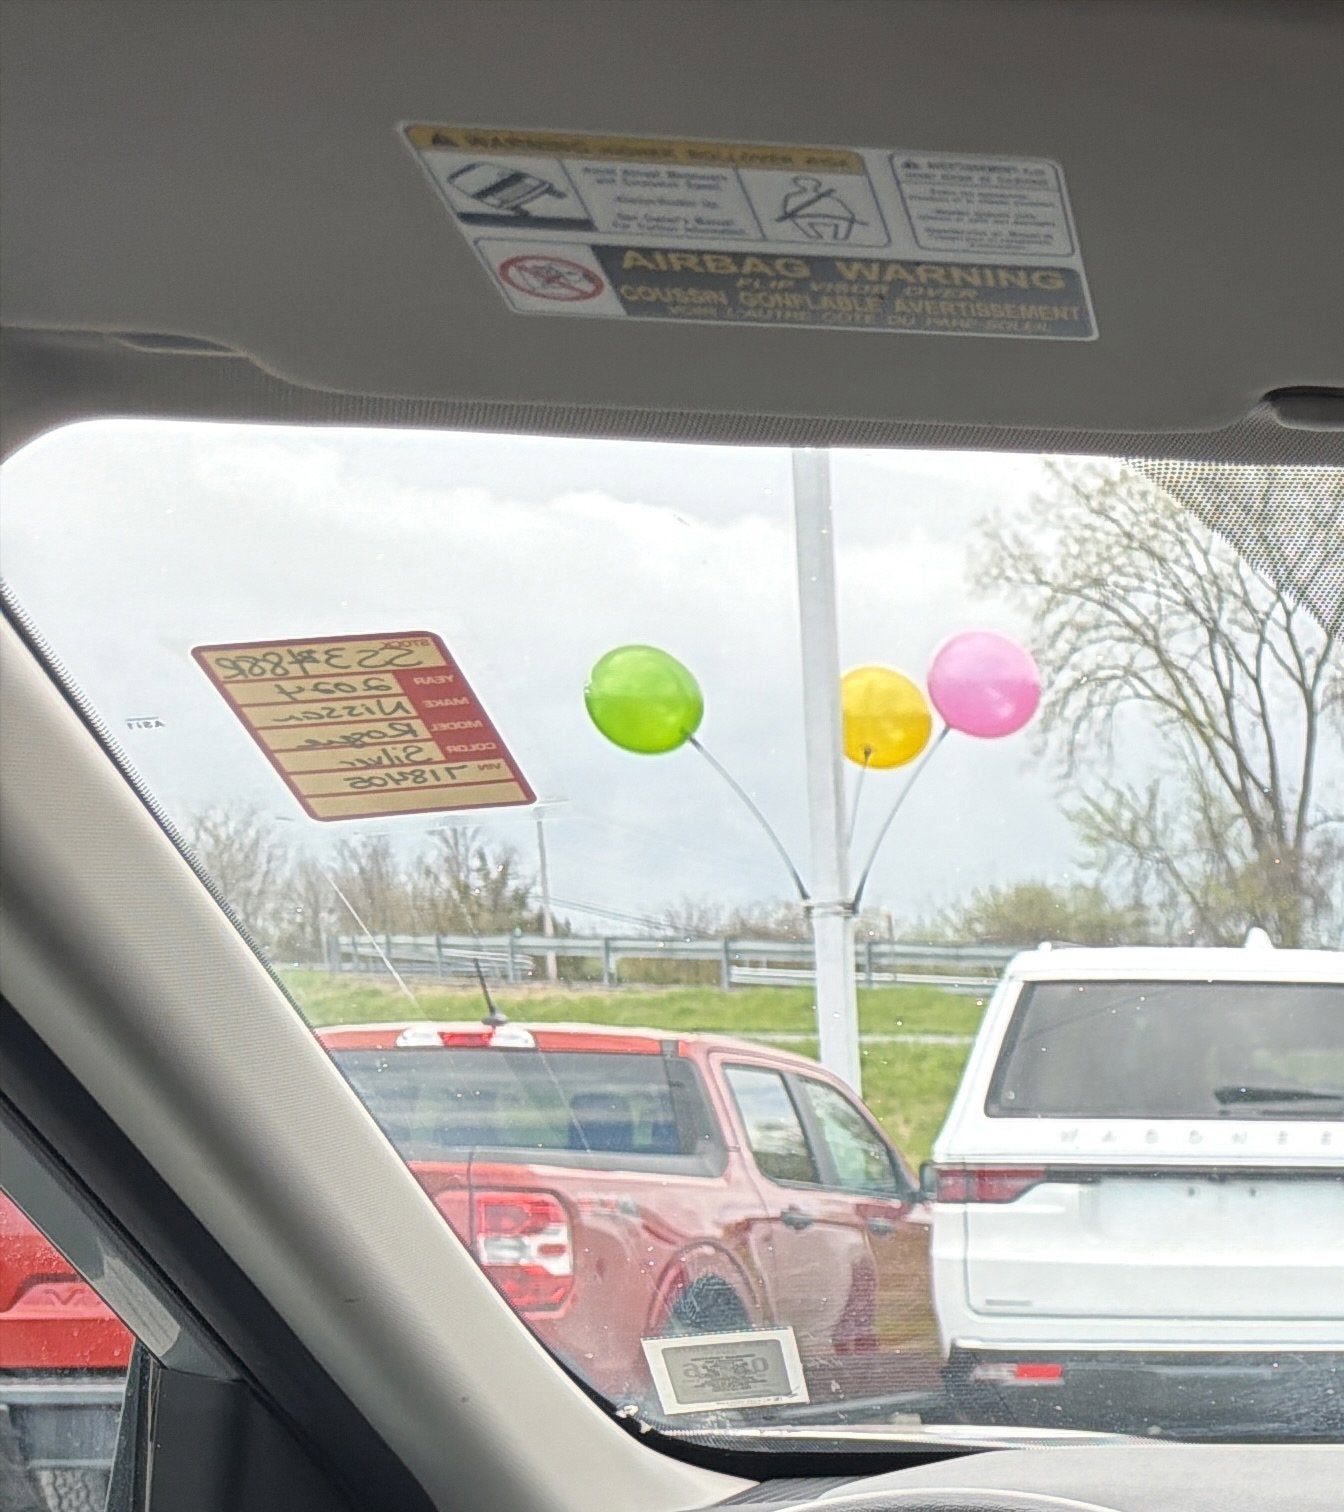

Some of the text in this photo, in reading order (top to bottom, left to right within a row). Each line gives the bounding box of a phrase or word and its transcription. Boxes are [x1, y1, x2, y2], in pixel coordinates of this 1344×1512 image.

[622, 249, 1066, 291] AIRBAG WARNING
[894, 298, 1083, 322] AVERTISSEMENT
